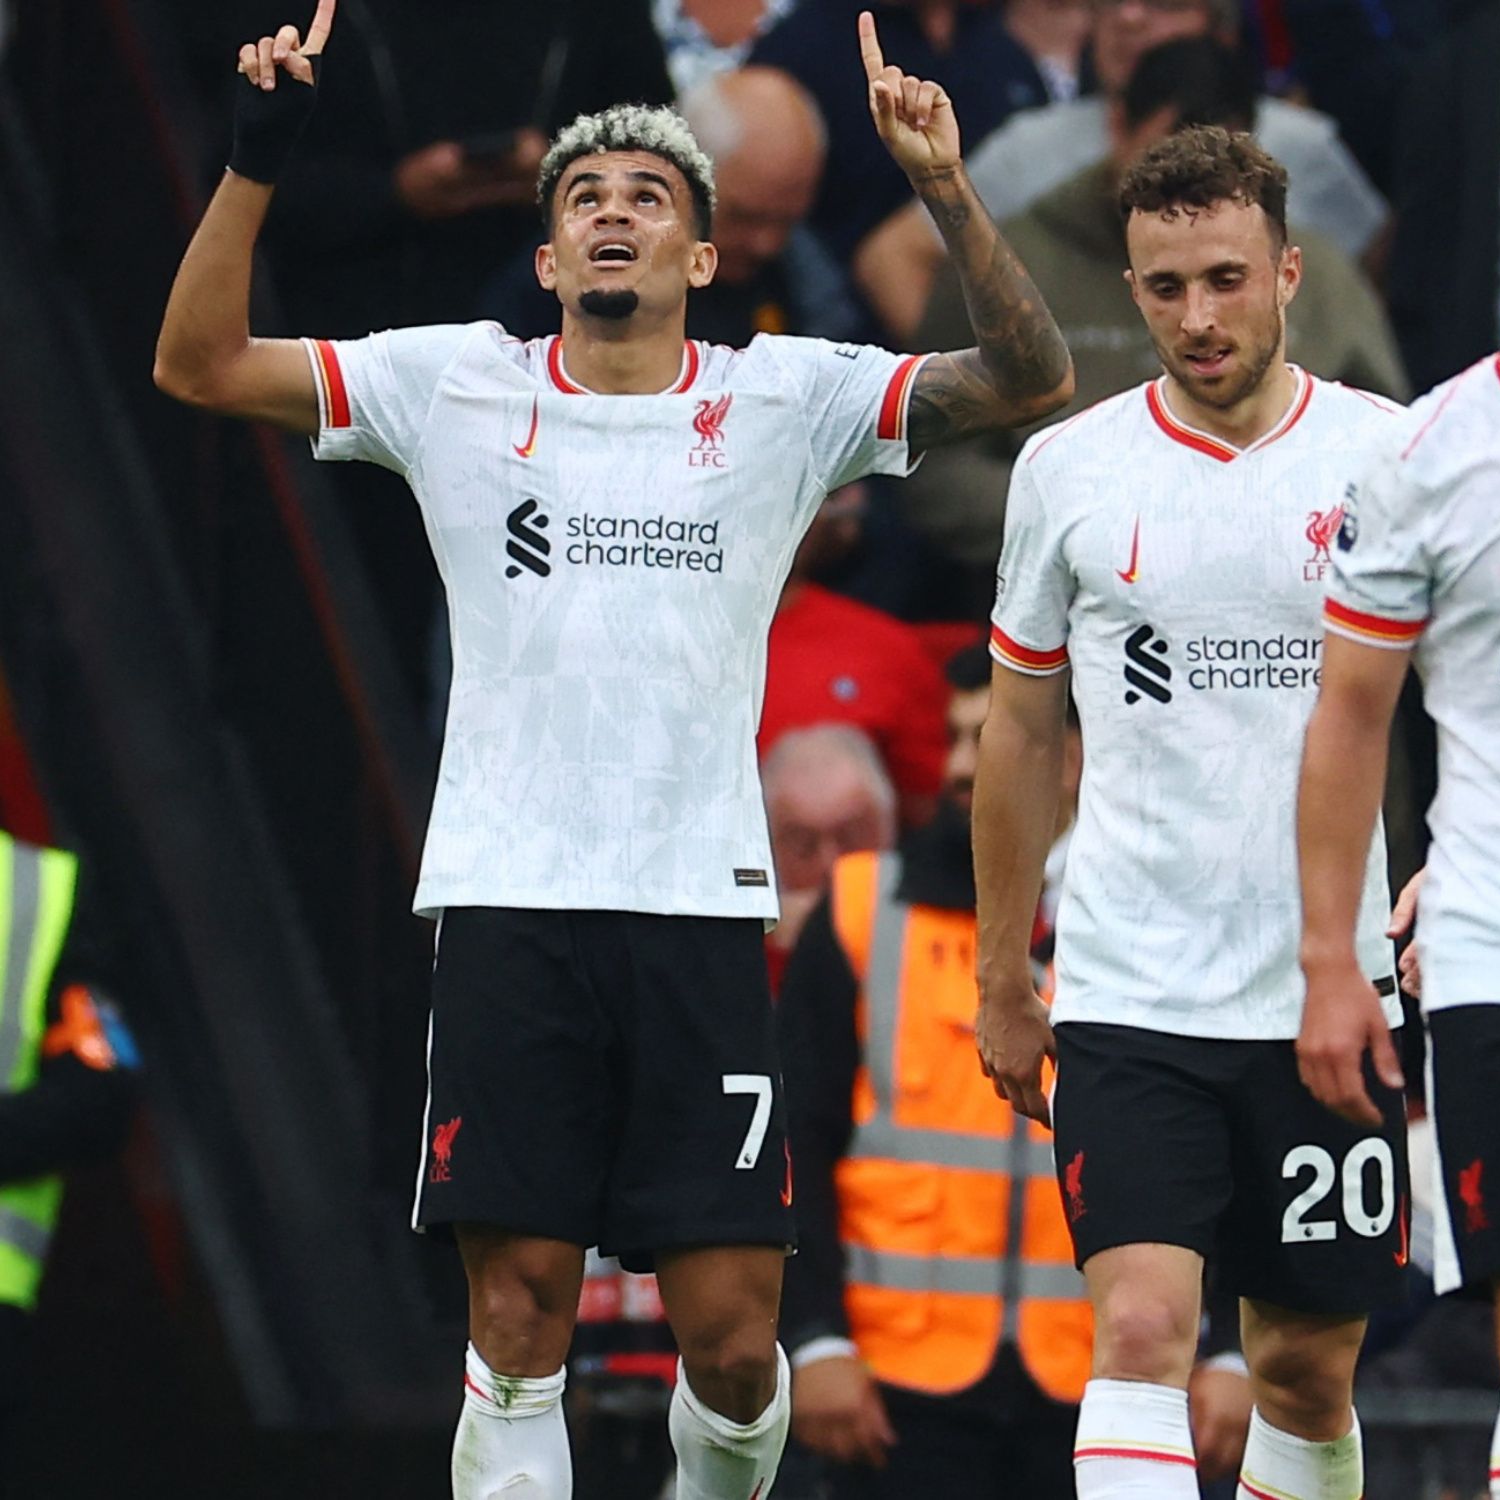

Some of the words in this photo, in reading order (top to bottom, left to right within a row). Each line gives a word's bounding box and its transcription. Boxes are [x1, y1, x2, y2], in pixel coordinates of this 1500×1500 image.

[566, 513, 719, 545] standard
[566, 540, 723, 574] chartered
[1187, 635, 1322, 661] standar
[1188, 663, 1321, 690] chartere
[722, 1074, 773, 1169] 7
[1281, 1136, 1395, 1244] 20
